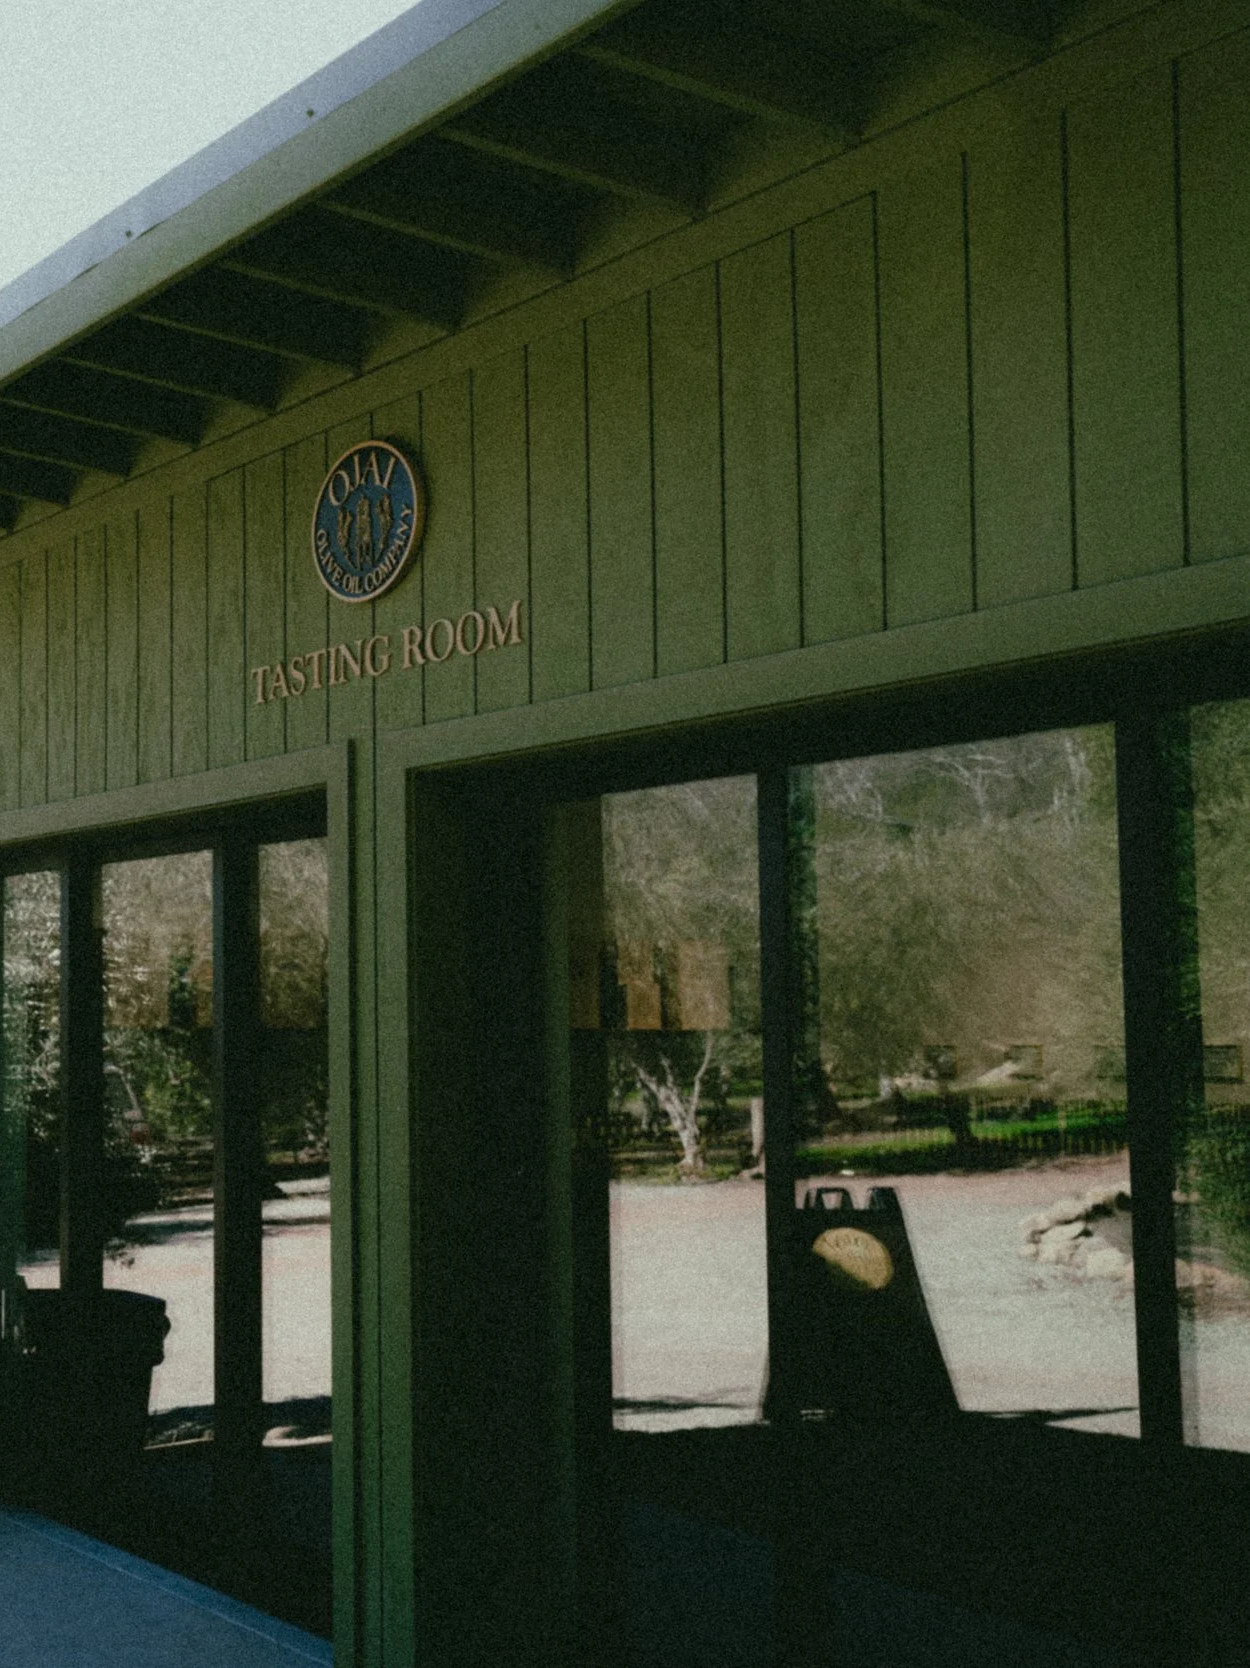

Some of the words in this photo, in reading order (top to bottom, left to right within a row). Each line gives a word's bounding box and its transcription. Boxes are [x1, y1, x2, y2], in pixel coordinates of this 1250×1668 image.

[328, 450, 398, 506] OJAI
[316, 529, 344, 587] OLIVE
[342, 573, 363, 594] OIL
[363, 504, 412, 591] COMPANY
[251, 635, 392, 704] TASTING
[402, 600, 522, 669] ROOM
